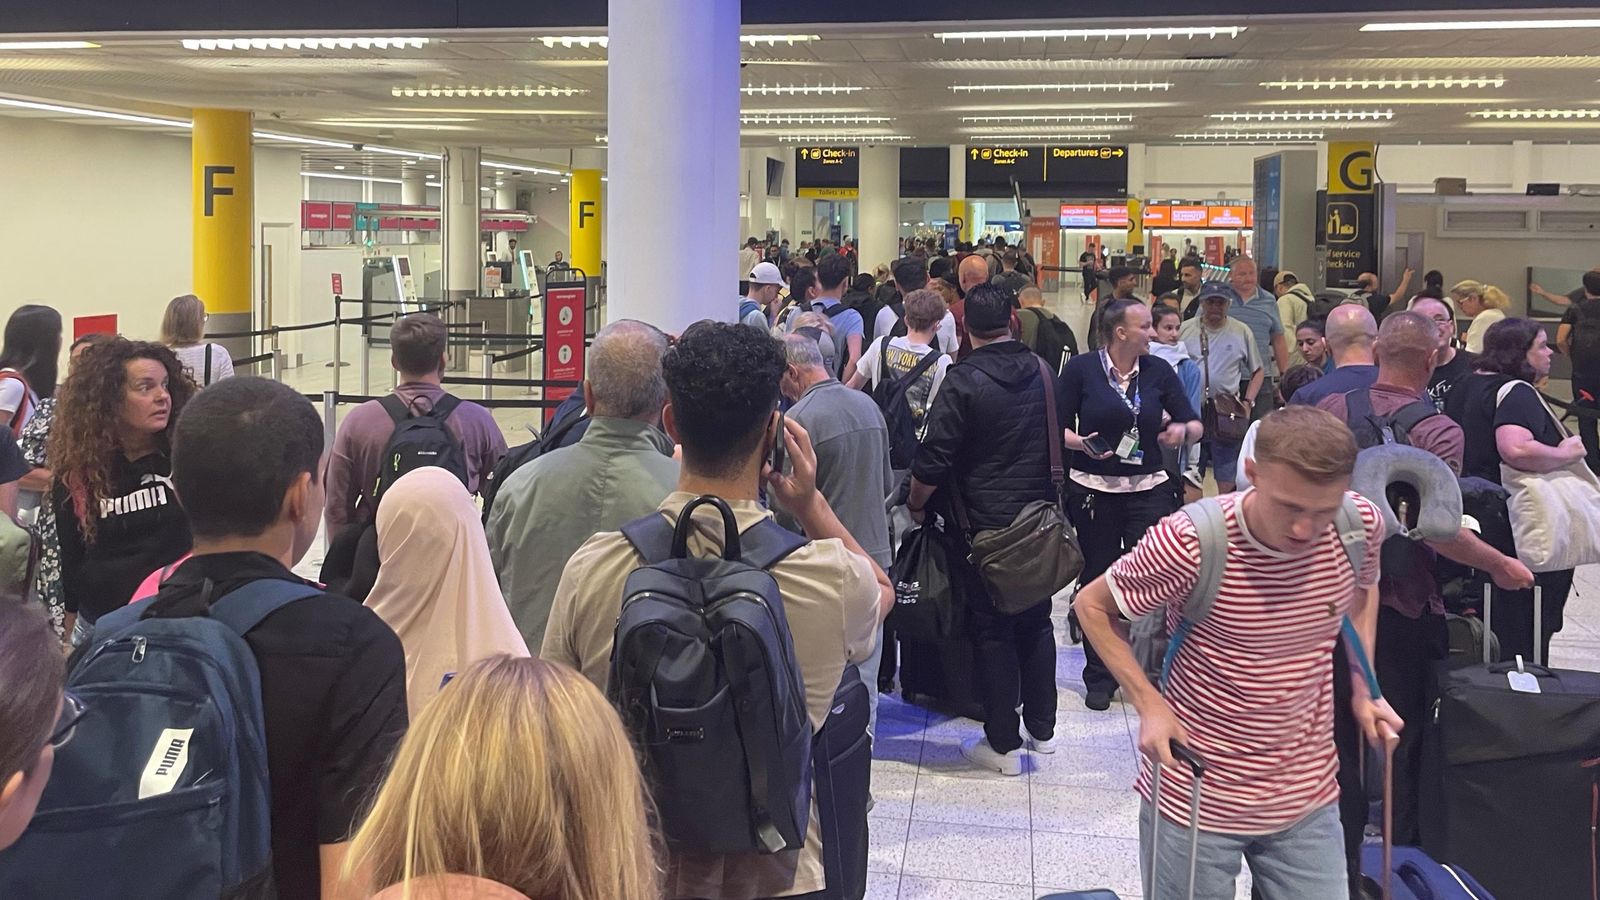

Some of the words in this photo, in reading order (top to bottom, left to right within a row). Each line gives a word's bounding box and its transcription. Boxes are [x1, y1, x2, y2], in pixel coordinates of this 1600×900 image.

[823, 148, 856, 158] Check-in
[993, 148, 1029, 158] Check-in
[1053, 148, 1098, 159] Departures
[1339, 150, 1372, 191] G
[204, 165, 235, 217] F
[579, 201, 595, 229] F
[1332, 249, 1361, 258] service
[897, 352, 919, 368] YORK
[100, 485, 167, 519] PUMA
[155, 738, 185, 776] PUMA
